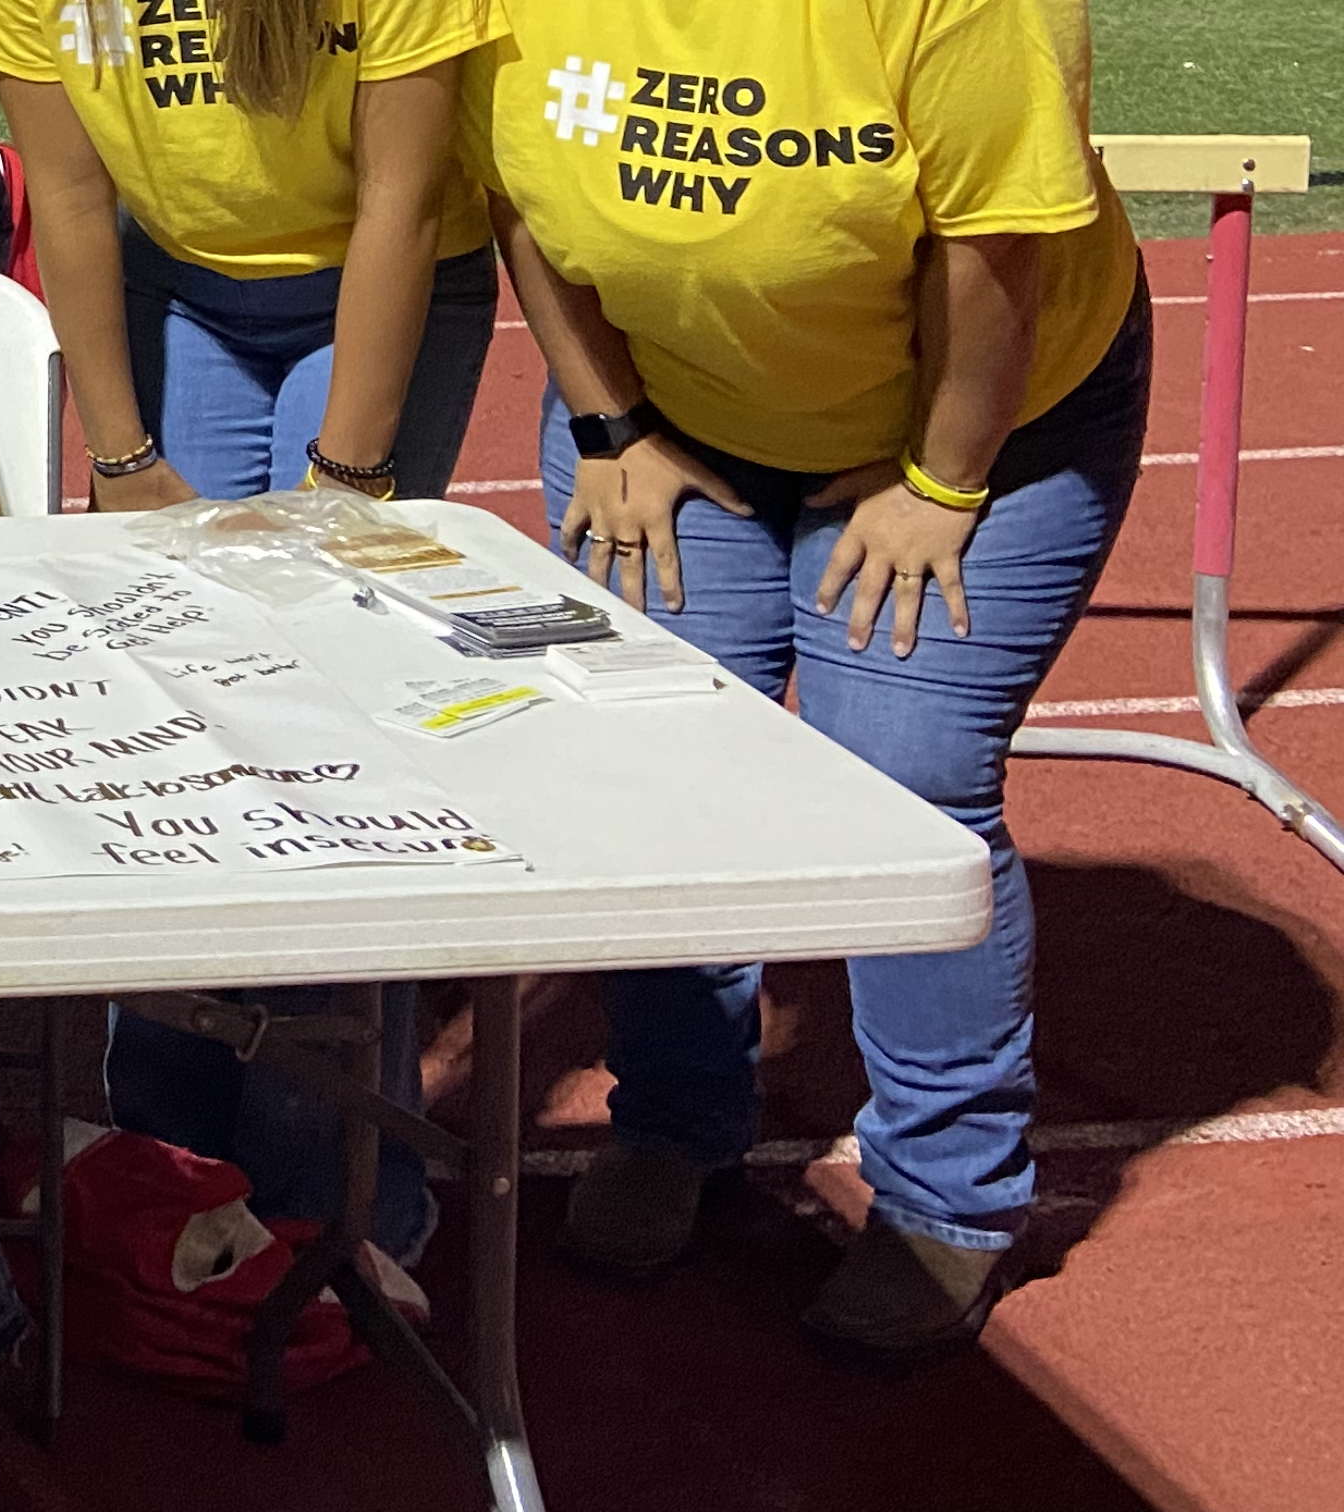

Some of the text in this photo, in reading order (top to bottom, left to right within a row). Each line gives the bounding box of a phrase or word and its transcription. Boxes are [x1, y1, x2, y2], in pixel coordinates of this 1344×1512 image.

[630, 67, 767, 117] ZERO
[619, 114, 896, 168] REASONS
[617, 161, 752, 216] WHY
[95, 809, 220, 838] You
[91, 833, 492, 866] feel insecur
